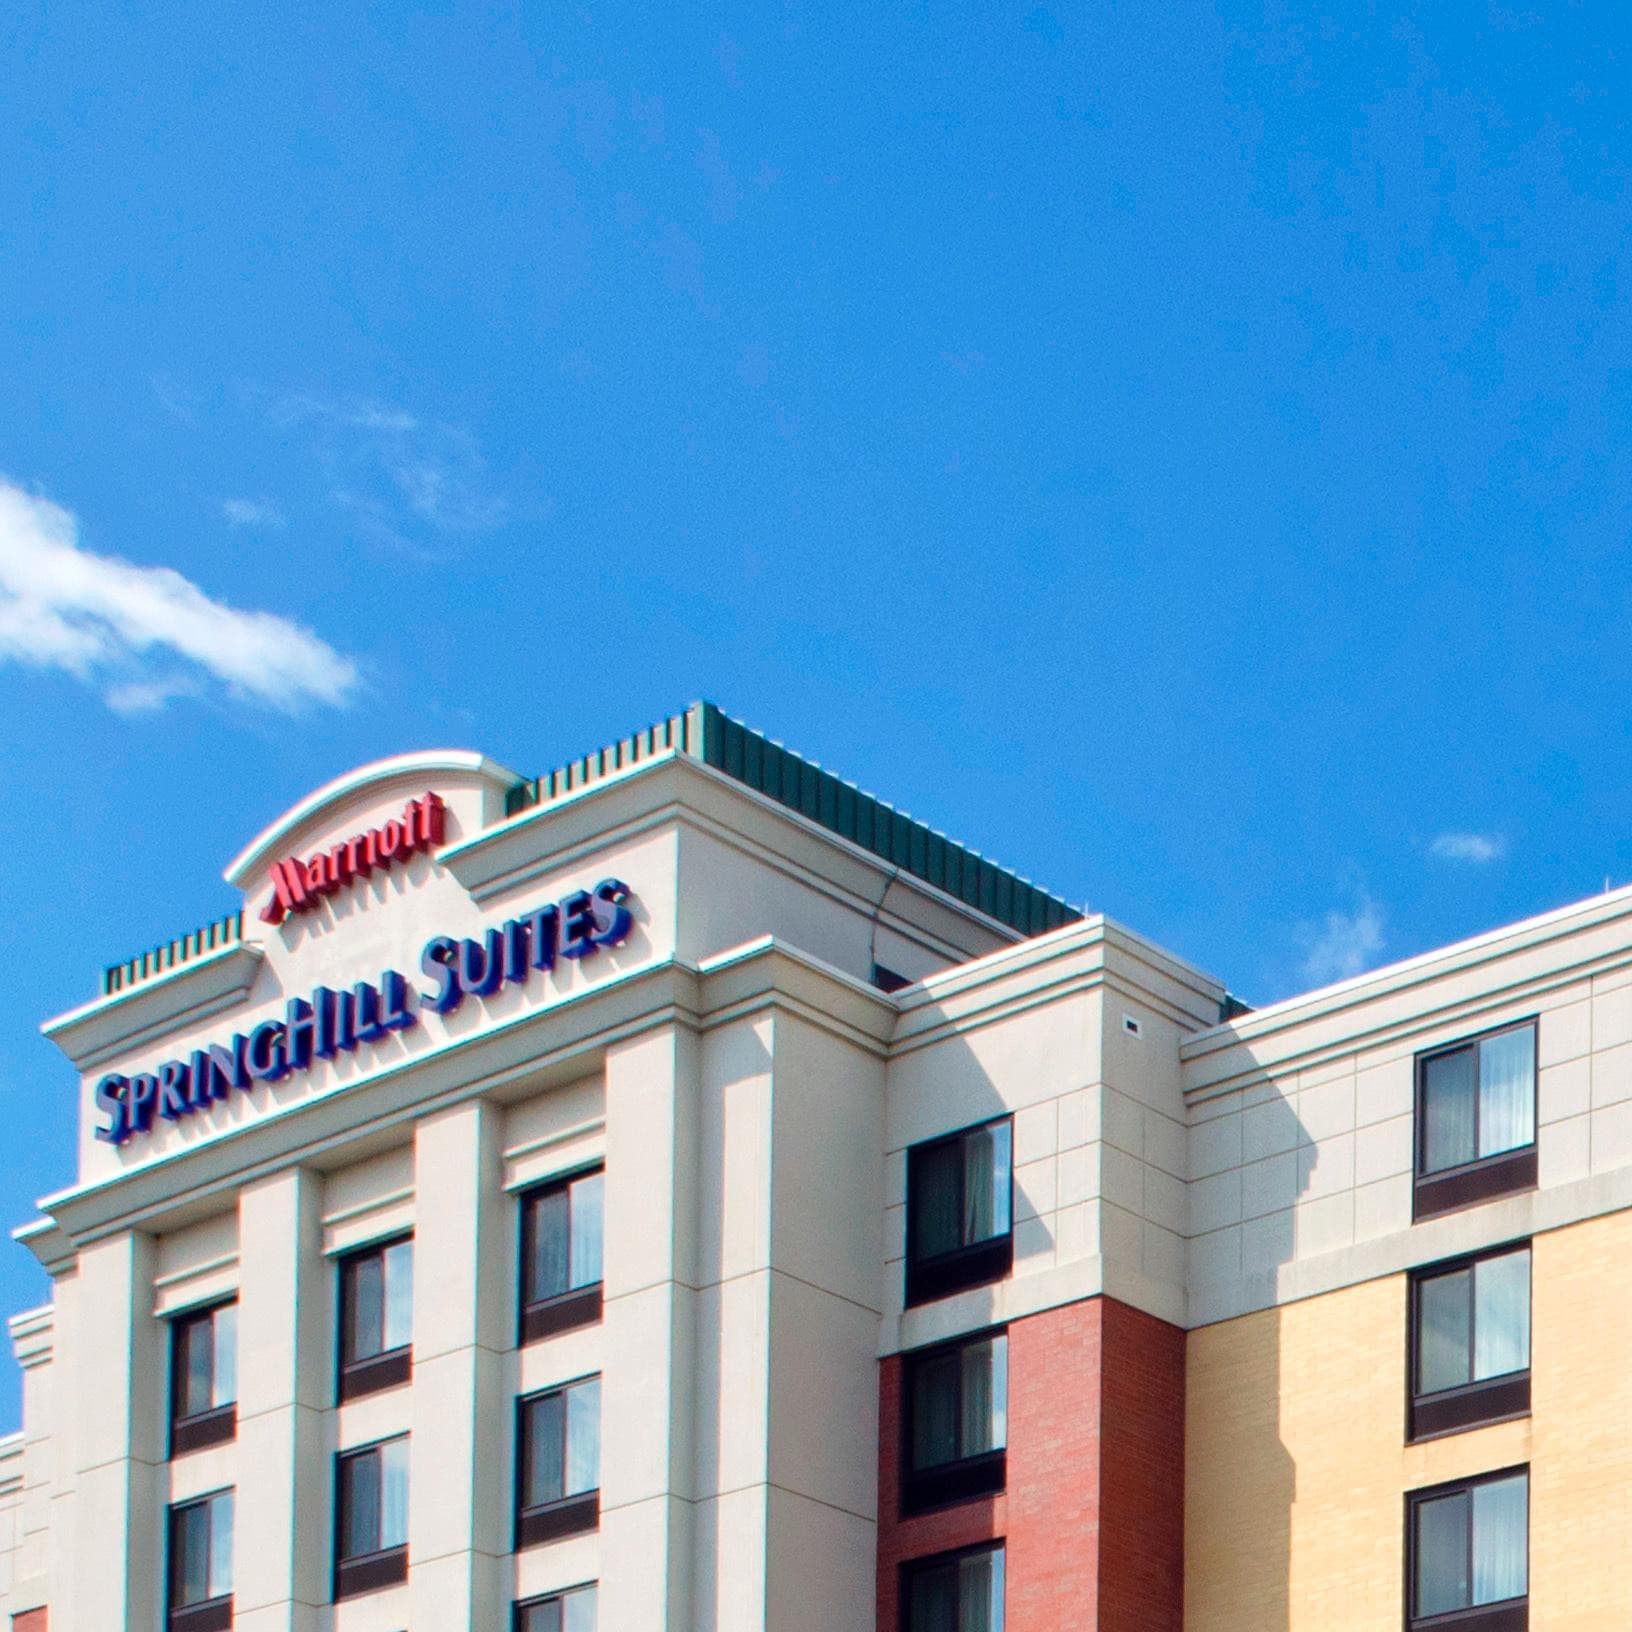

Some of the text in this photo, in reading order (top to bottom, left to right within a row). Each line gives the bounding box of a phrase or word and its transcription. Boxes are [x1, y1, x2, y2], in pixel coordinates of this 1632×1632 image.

[258, 791, 446, 925] Marriott
[94, 877, 633, 1145] SPRINGHILL SUITES
